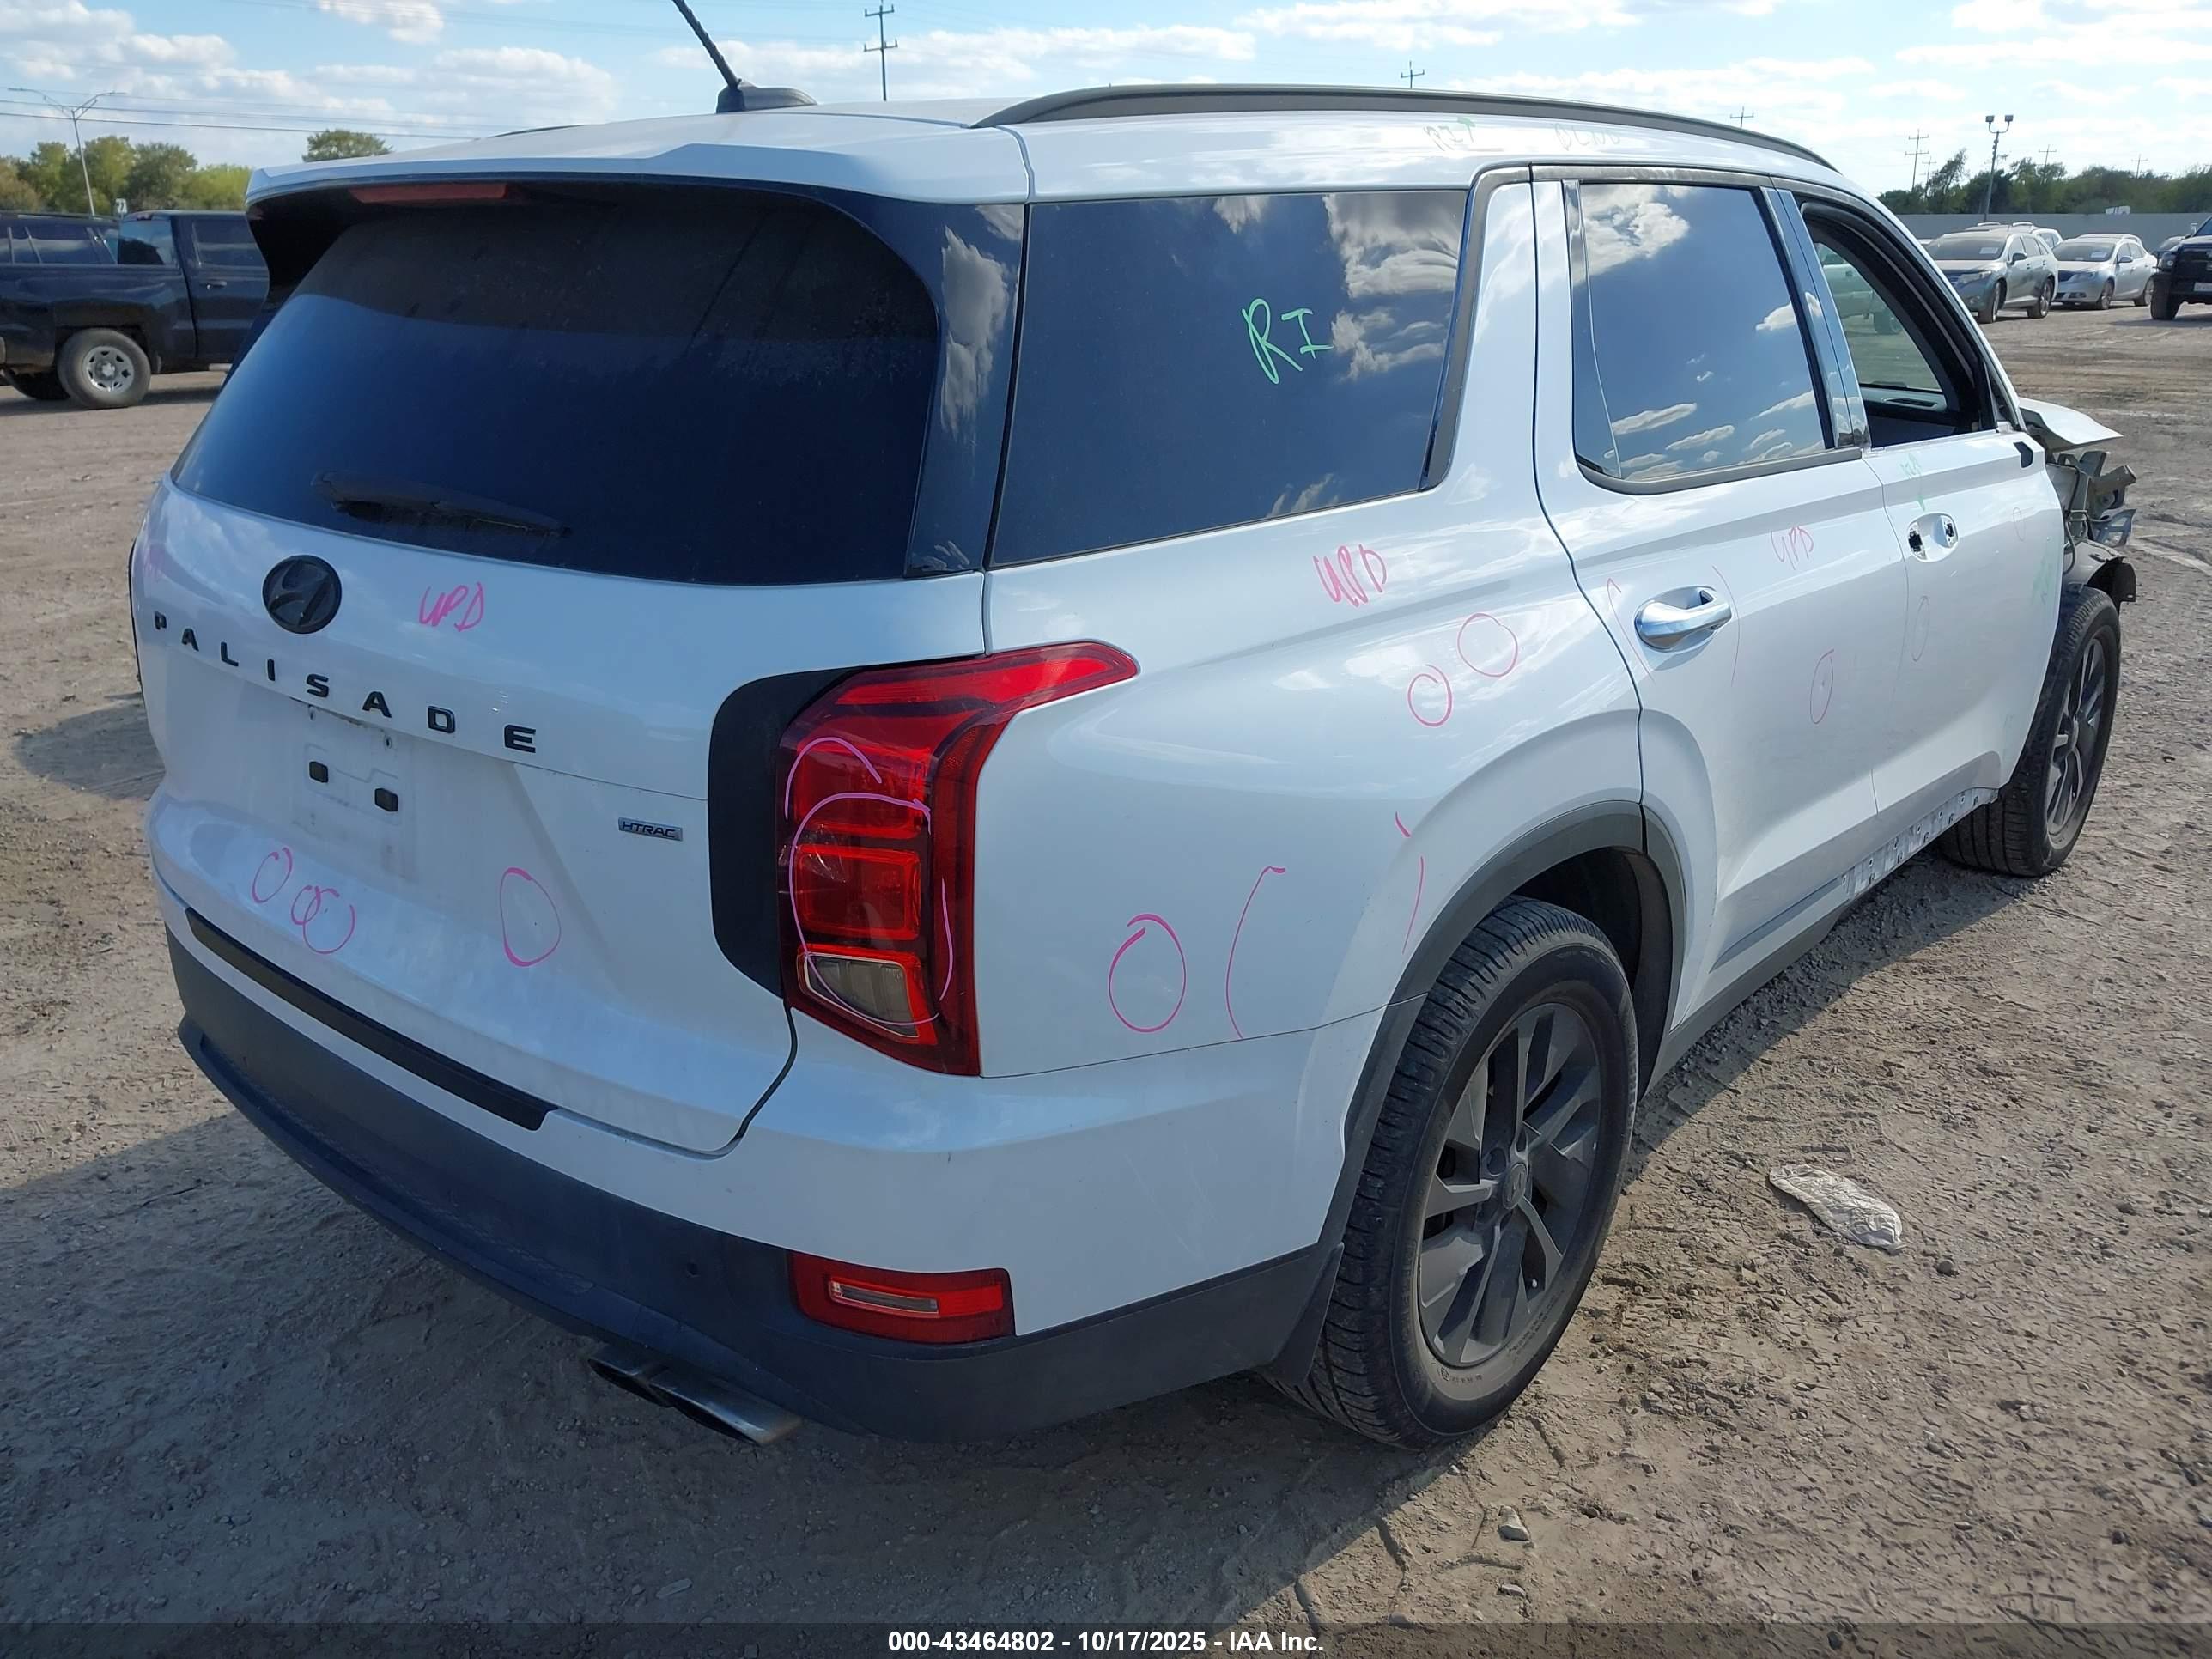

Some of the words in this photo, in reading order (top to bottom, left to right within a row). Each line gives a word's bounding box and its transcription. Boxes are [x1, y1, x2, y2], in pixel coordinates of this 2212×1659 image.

[1241, 297, 1334, 385] RI
[154, 611, 537, 753] PALISADE
[622, 820, 677, 838] HTRAC
